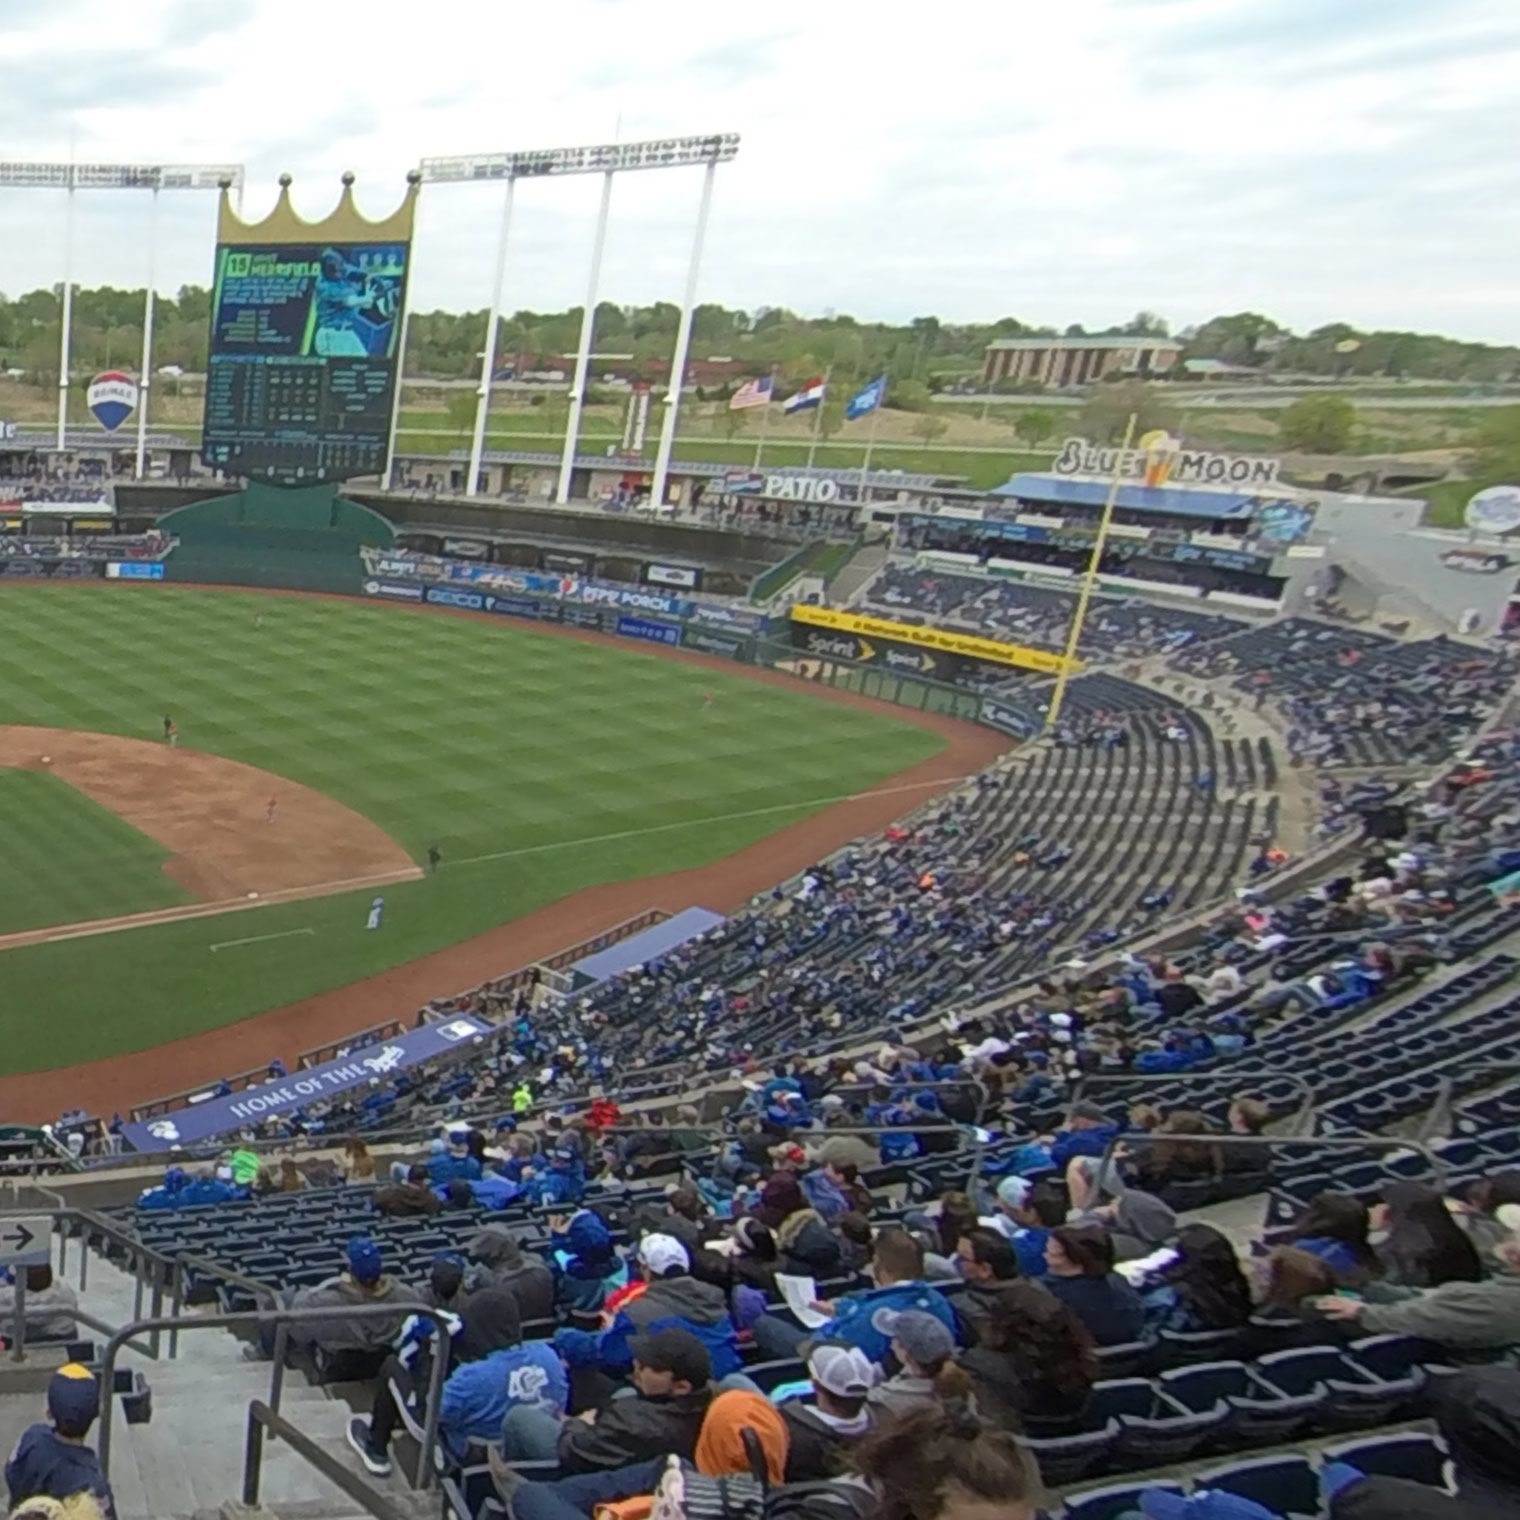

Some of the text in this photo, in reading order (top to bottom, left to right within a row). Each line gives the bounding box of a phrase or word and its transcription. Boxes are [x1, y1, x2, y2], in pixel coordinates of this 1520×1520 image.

[231, 256, 247, 272] 15
[1056, 441, 1275, 481] BLUE MOON
[764, 475, 837, 501] PATIO
[621, 591, 671, 611] PORCH
[807, 632, 855, 658] Sprint
[886, 649, 920, 668] Sprint
[230, 1088, 297, 1118] HOME
[294, 1077, 323, 1094] OF
[321, 1063, 368, 1084] THE
